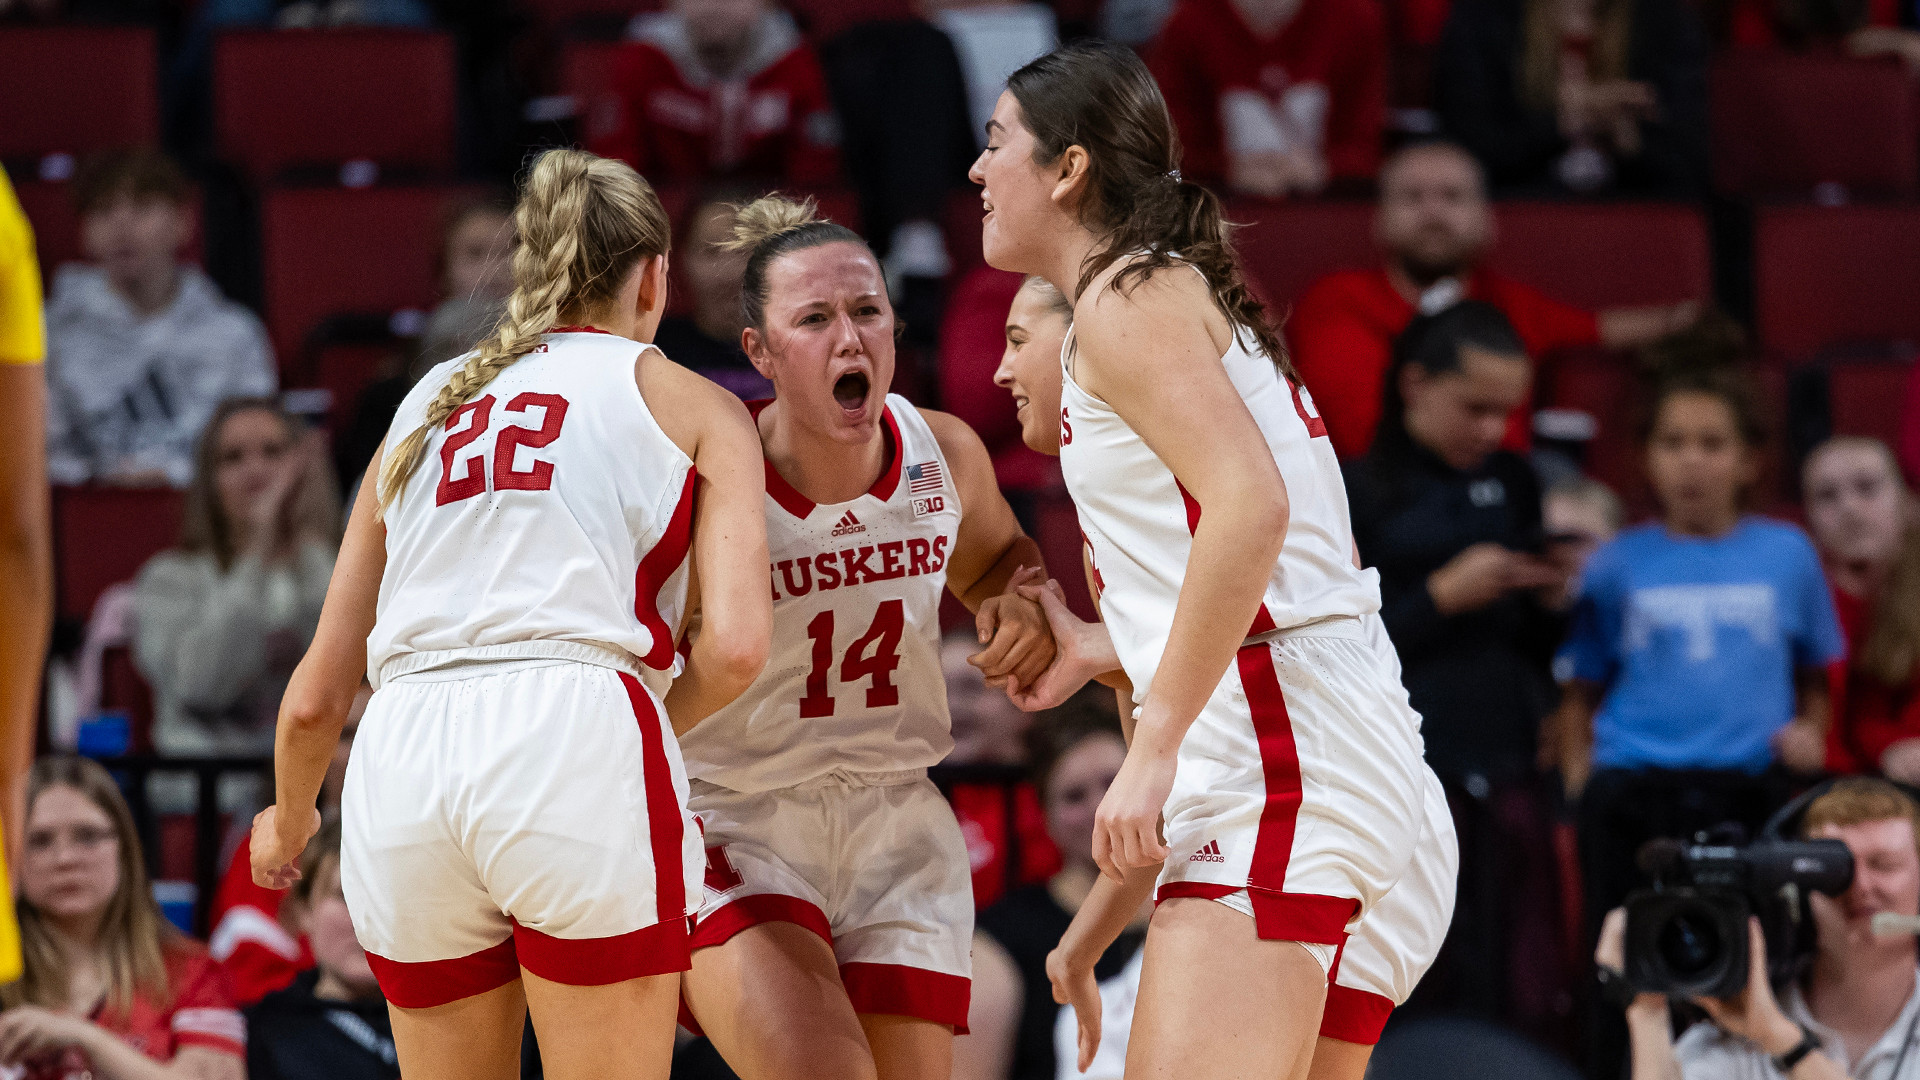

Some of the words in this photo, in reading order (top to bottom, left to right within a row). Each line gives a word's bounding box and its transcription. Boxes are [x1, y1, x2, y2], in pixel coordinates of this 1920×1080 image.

[435, 392, 570, 507] 22
[831, 525, 866, 537] adidas
[799, 598, 904, 718] 14
[1189, 854, 1225, 863] adidas
